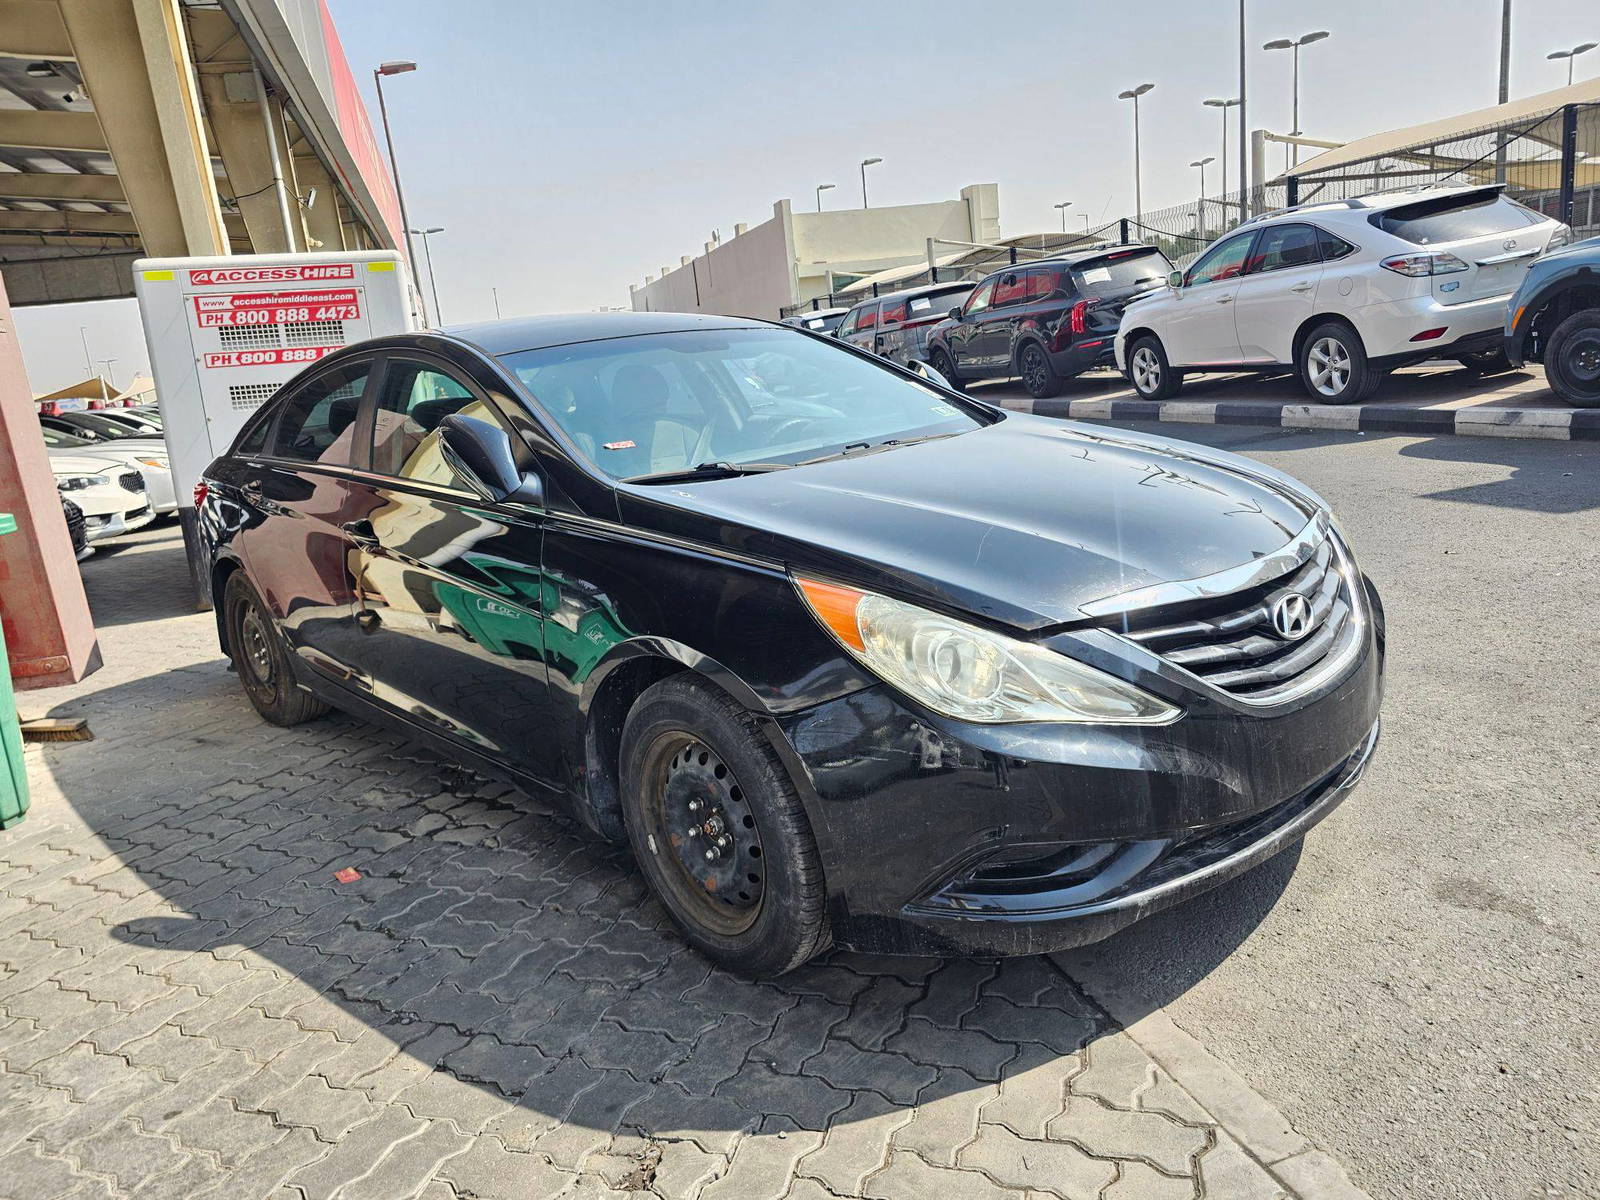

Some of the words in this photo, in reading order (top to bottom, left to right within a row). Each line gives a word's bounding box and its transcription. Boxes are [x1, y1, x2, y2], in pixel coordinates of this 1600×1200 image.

[215, 269, 298, 282] ACCESS
[303, 266, 352, 278] HIRE
[233, 294, 354, 306] accesshiremiddleeast.com
[206, 314, 223, 324] PH
[235, 310, 269, 324] 800
[276, 308, 309, 322] 888
[315, 306, 358, 320] 4473
[211, 355, 231, 365] PH
[240, 351, 276, 364] 800
[281, 349, 317, 361] 888
